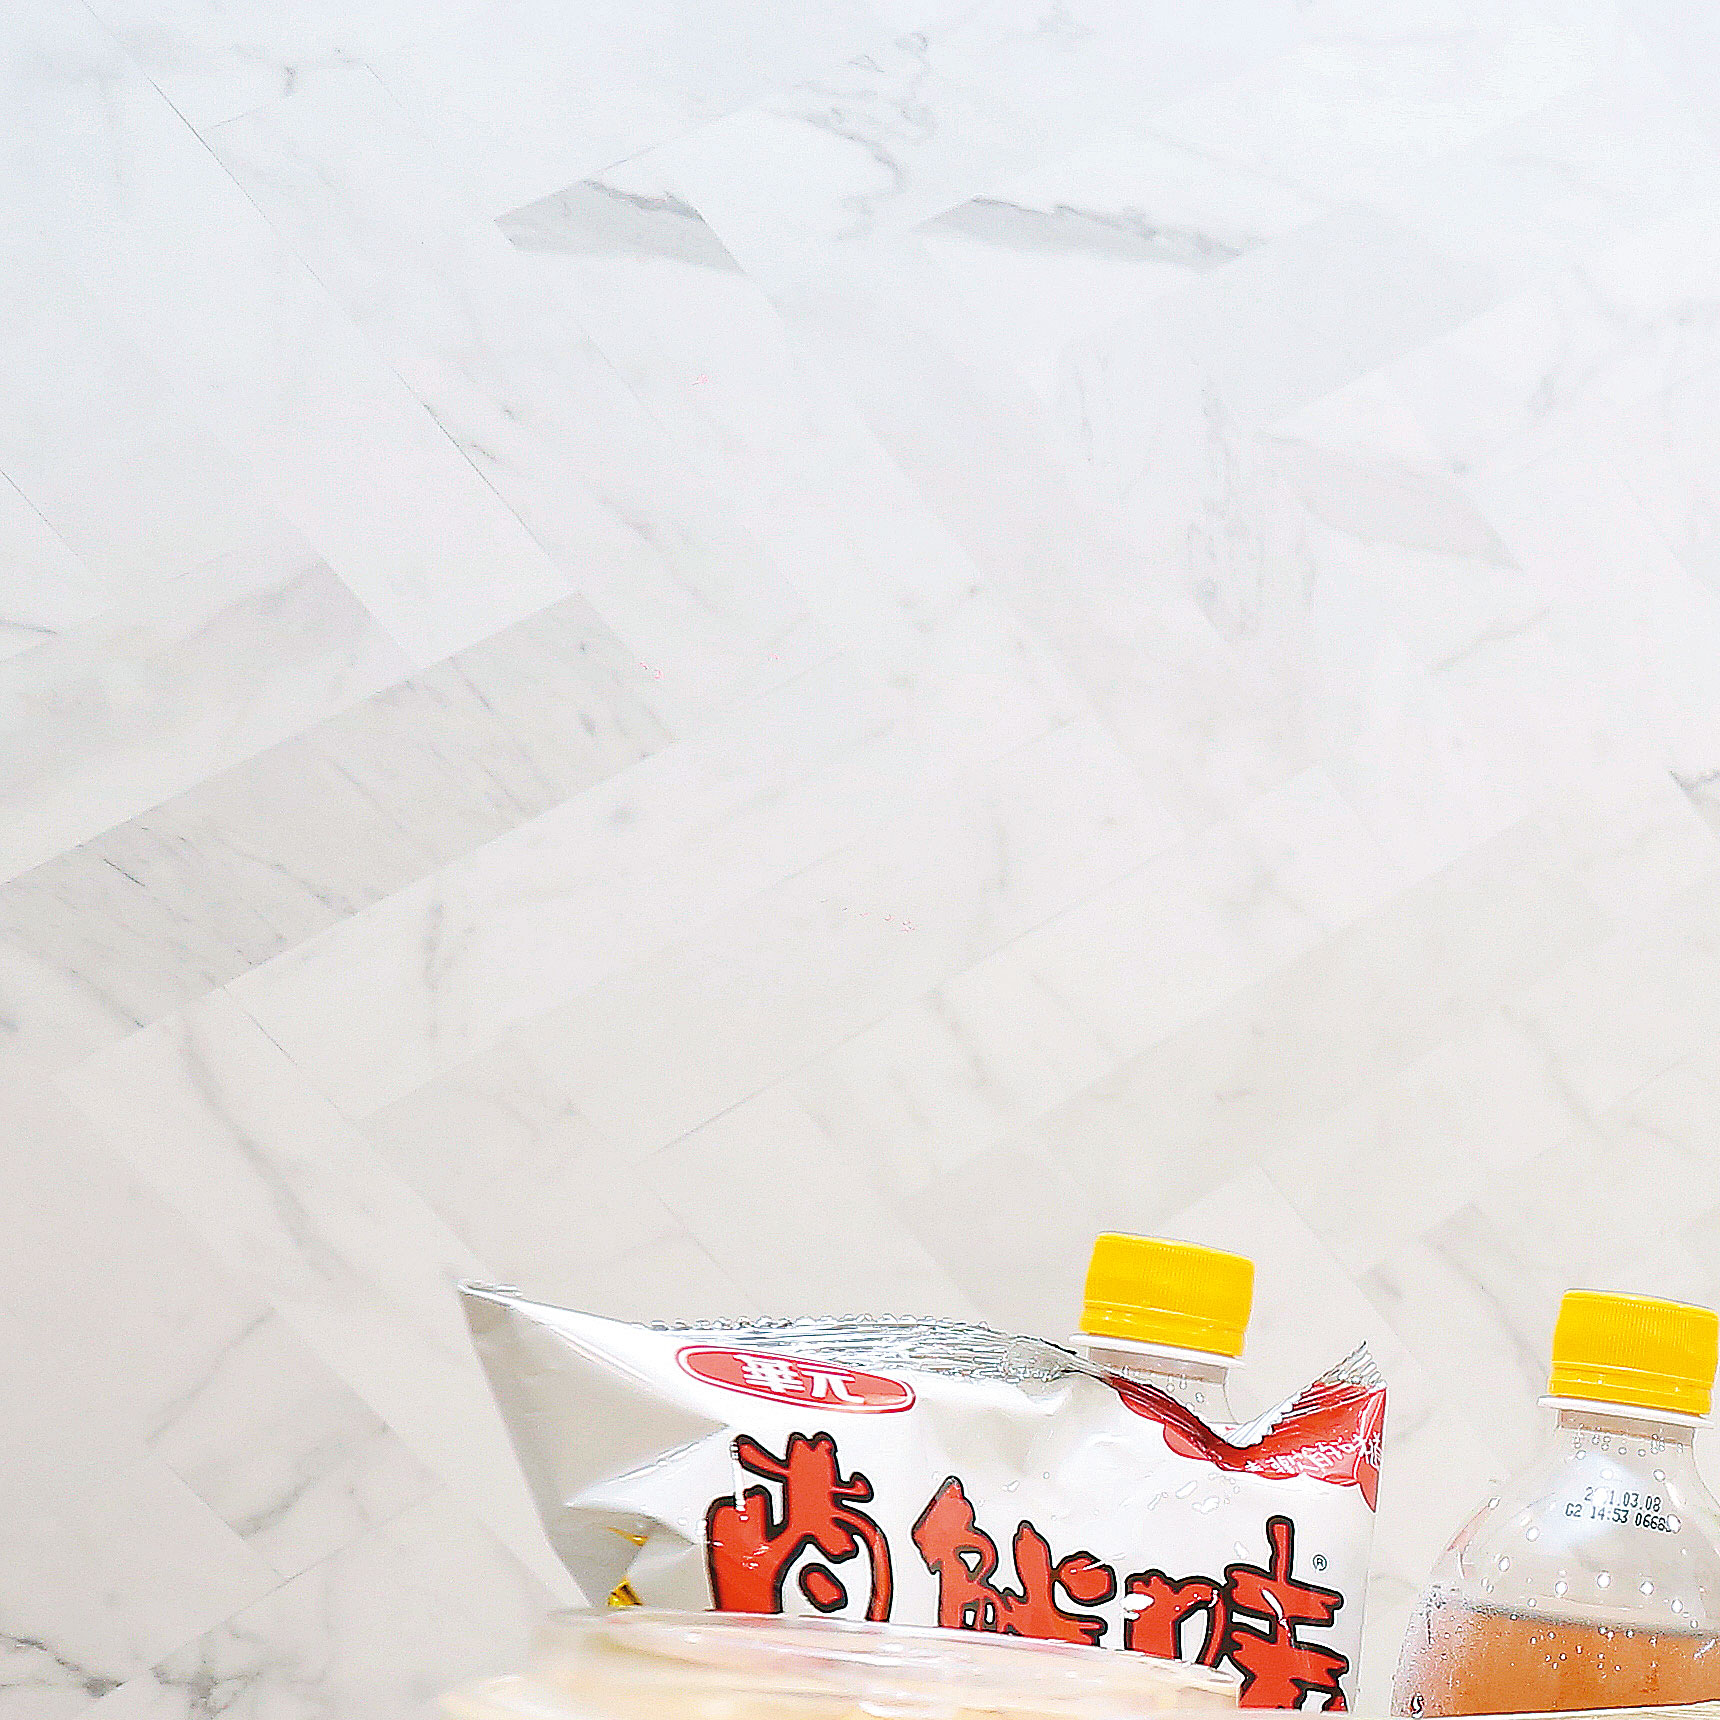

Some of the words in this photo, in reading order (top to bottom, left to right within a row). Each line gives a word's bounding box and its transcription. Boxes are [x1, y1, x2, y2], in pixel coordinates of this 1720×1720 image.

[733, 1353, 864, 1404] 華元
[1585, 1487, 1661, 1512] 21.03.08
[1590, 1506, 1629, 1524] 14:53
